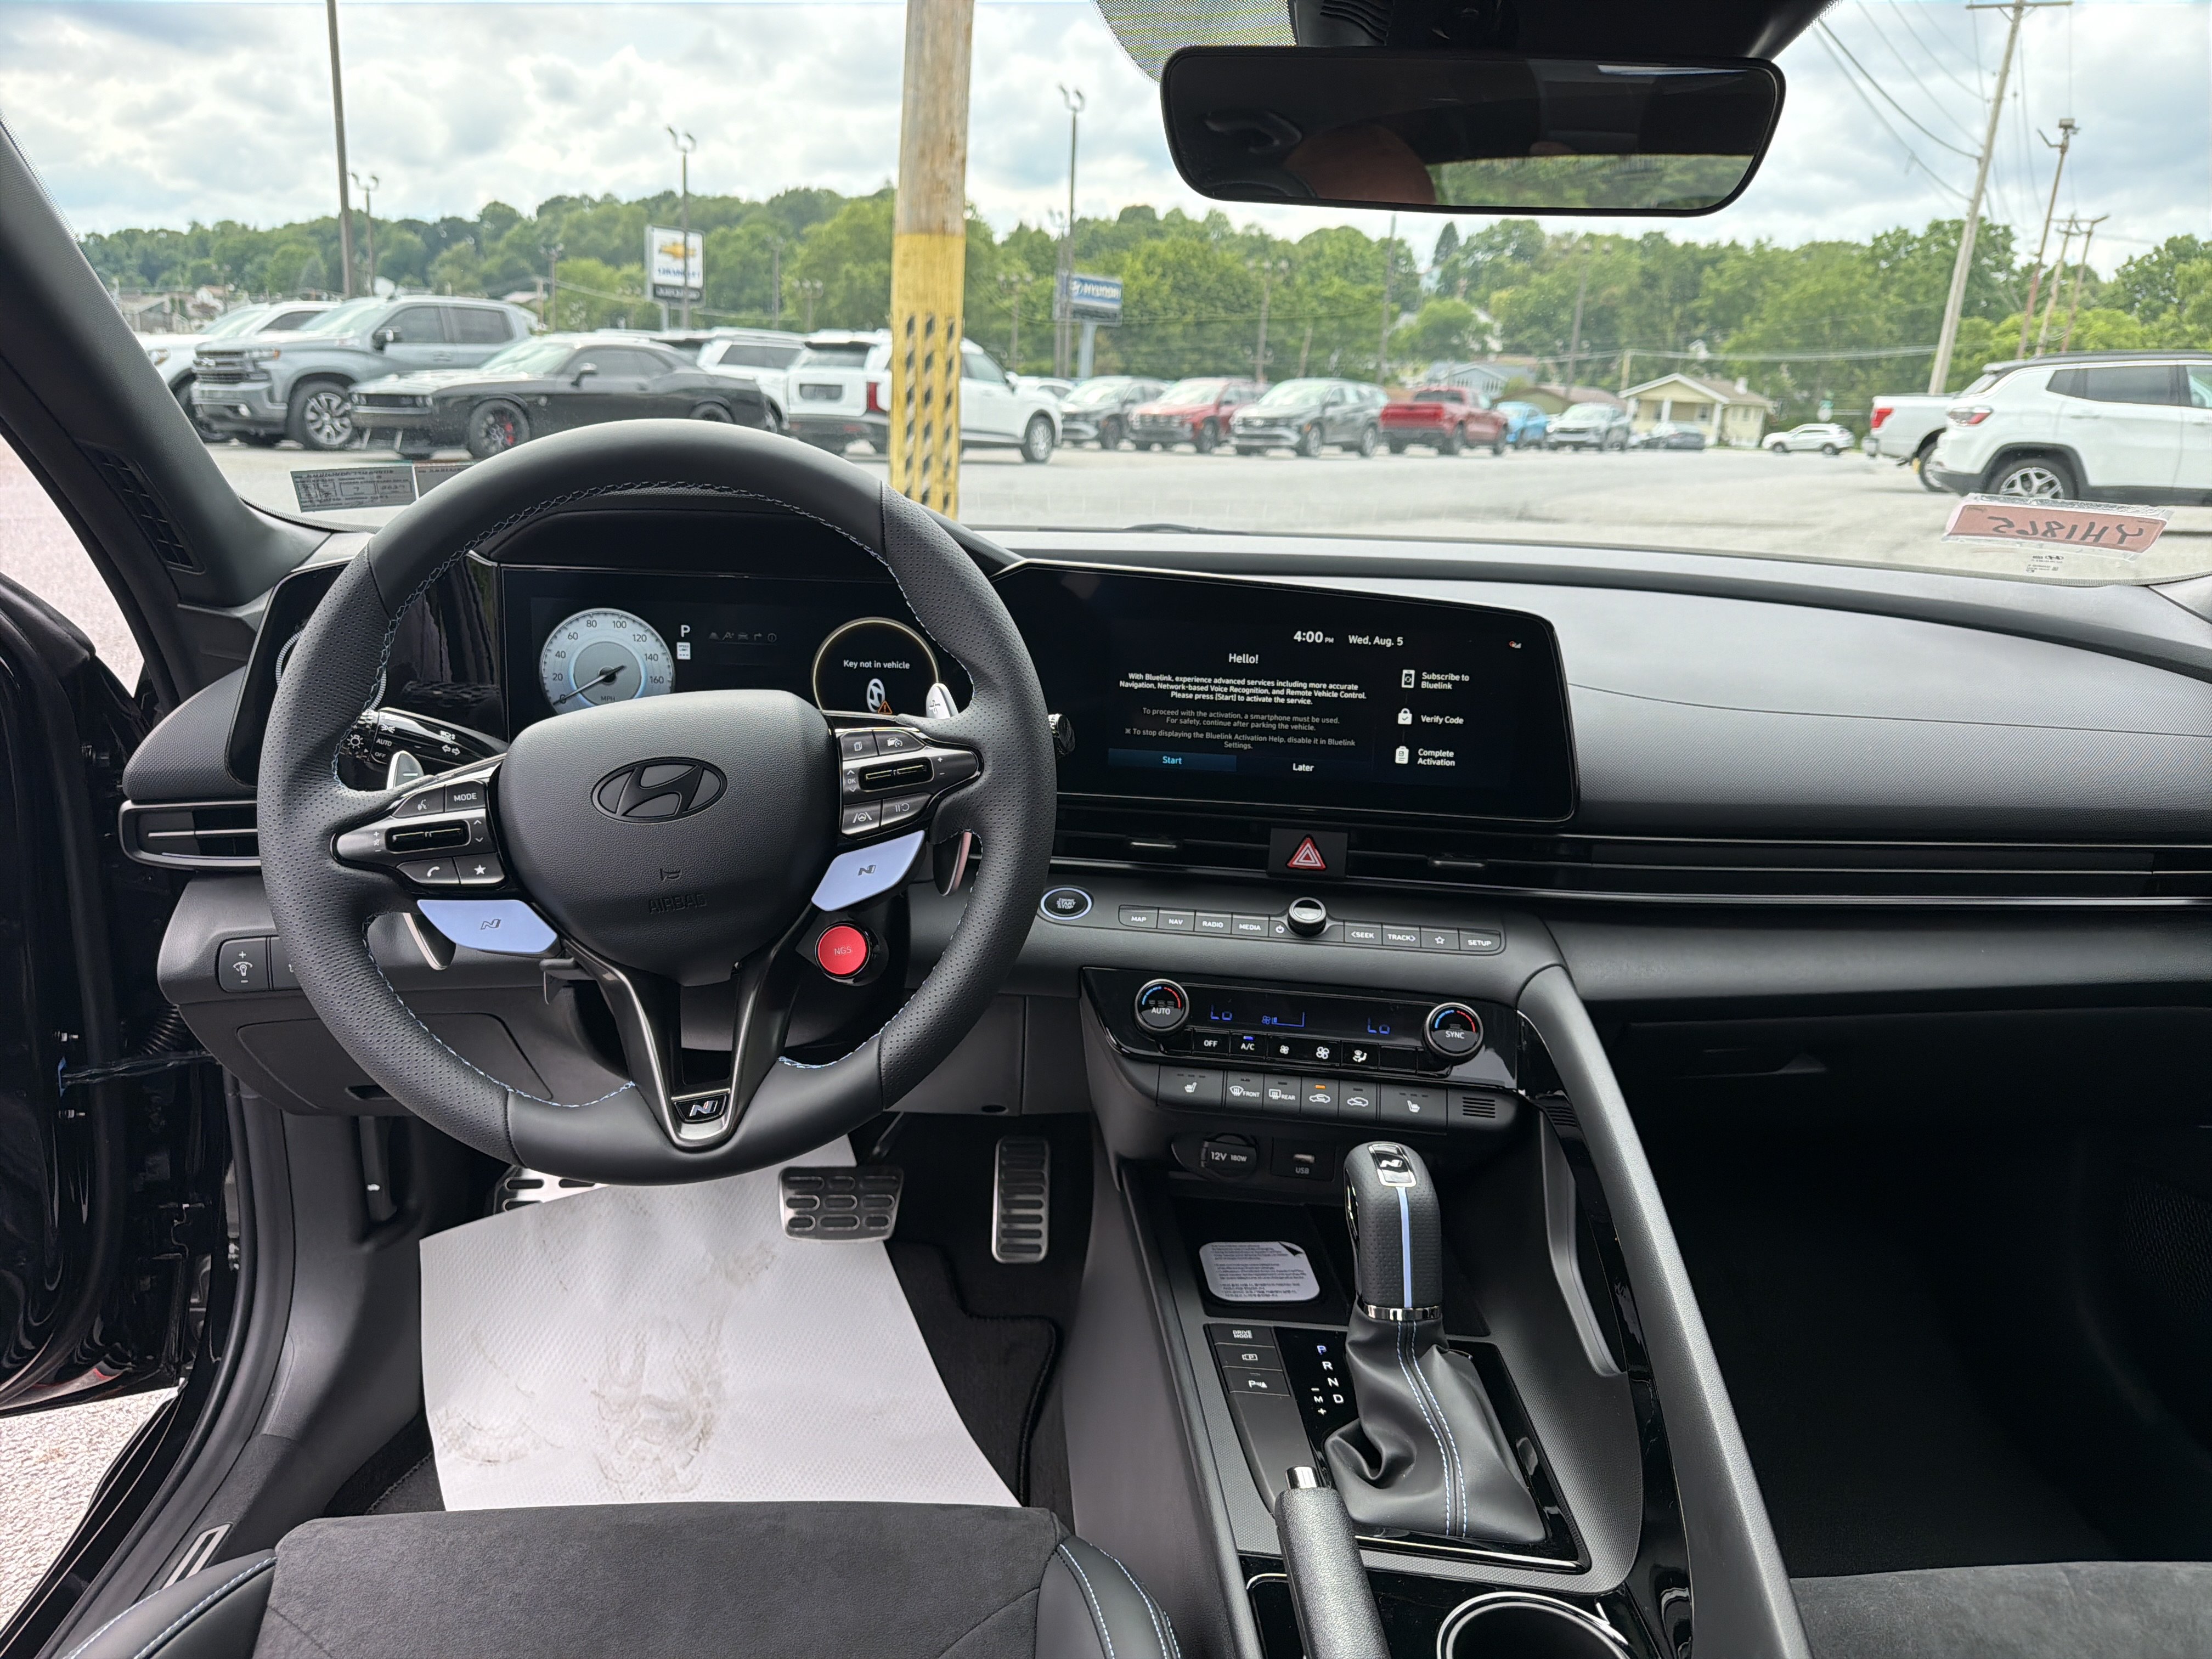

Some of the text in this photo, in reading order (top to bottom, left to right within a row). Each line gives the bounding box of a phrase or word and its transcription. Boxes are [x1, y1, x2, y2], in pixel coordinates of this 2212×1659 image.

[586, 619, 597, 628] 80
[612, 620, 627, 629] 100
[681, 624, 691, 637] P
[1294, 631, 1323, 643] 4:00
[1348, 635, 1403, 647] Wed, Aug. 5
[645, 653, 658, 662] 140
[1229, 653, 1259, 664] Hello!
[843, 659, 858, 669] Key
[883, 661, 910, 669] vehicle
[1145, 674, 1174, 682] Bluelink,
[1214, 676, 1245, 685] advanced
[1276, 680, 1307, 689] including
[1421, 672, 1460, 681] Subscribe
[1120, 681, 1156, 689] Navigation,
[1158, 682, 1208, 691] Network-based
[1229, 686, 1271, 695] Recognition,
[1286, 689, 1312, 697] Remote
[1340, 691, 1367, 699] Control.
[1421, 681, 1453, 690] Bluelink
[1152, 708, 1179, 716] proceed
[1250, 713, 1290, 722] smartphone
[1421, 715, 1464, 725] Verify Code
[1180, 718, 1201, 726] safety,
[1250, 722, 1277, 730] parking
[1158, 730, 1192, 739] displaying
[376, 738, 392, 747] AUTO
[1224, 742, 1253, 750] Settings.
[1418, 748, 1454, 758] Complete
[1163, 756, 1182, 765] Start
[1418, 758, 1455, 766] Activation
[1293, 763, 1314, 771] Later
[454, 793, 477, 802] MODE
[648, 894, 707, 914] AIRBAG
[1445, 1030, 1465, 1040] SYNC
[1211, 1152, 1227, 1161] 12V
[1317, 1345, 1327, 1355] P
[1322, 1361, 1333, 1371] R
[1327, 1377, 1339, 1387] N
[1333, 1394, 1344, 1404] D
